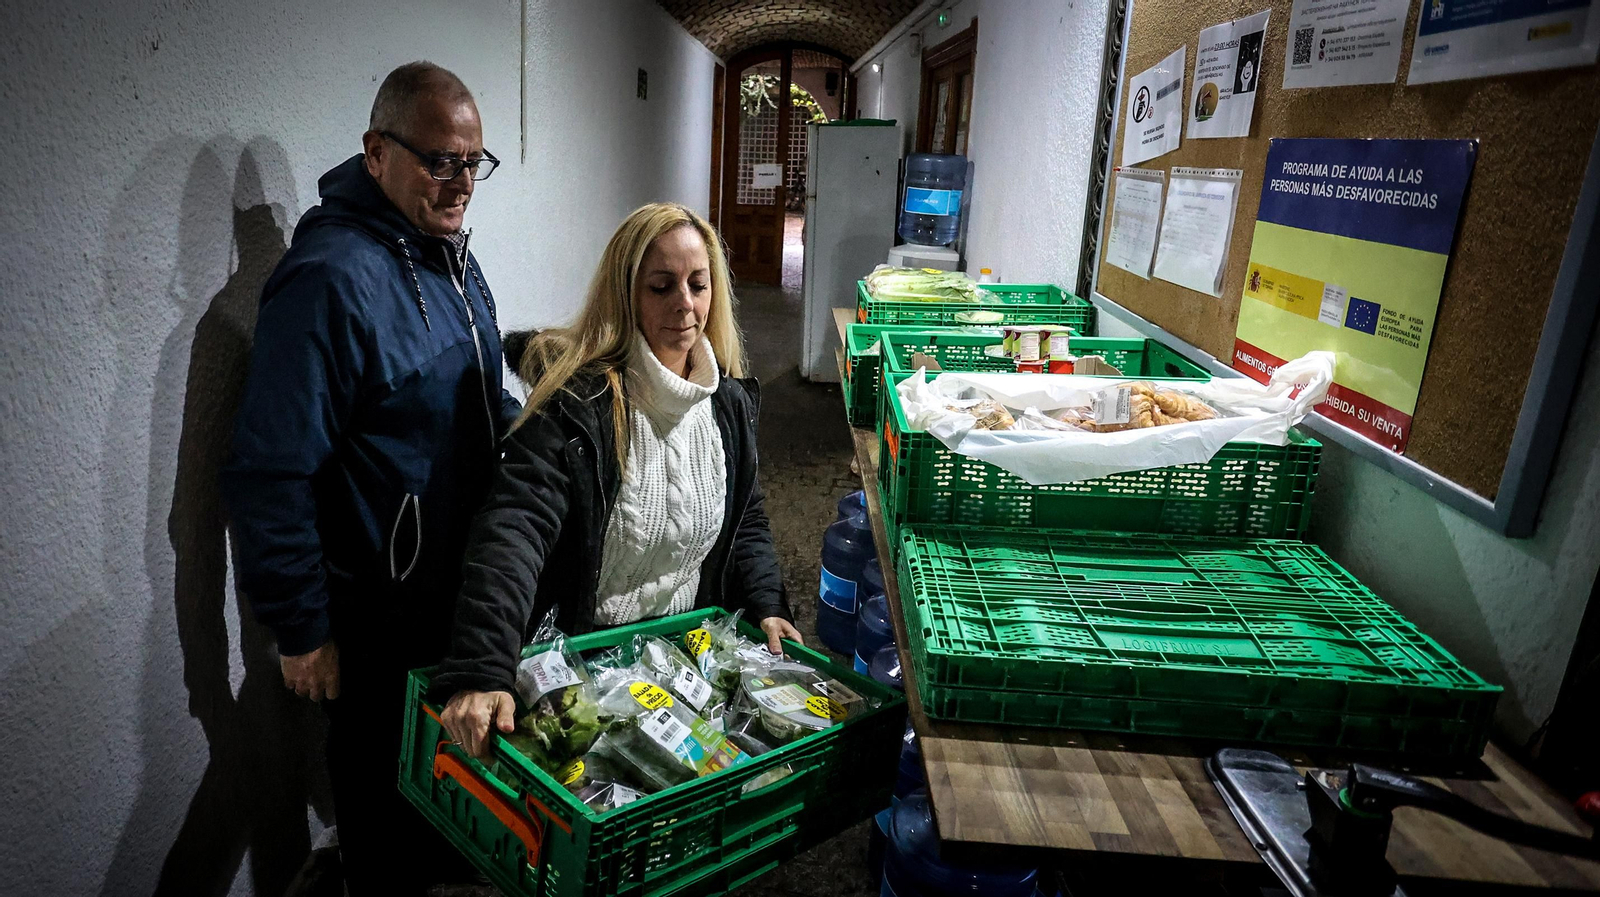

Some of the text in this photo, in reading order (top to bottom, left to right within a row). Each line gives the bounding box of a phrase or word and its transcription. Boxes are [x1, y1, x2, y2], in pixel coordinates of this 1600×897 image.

[1282, 161, 1423, 184] PROGRAMA DE AYUDA A LAS
[1270, 180, 1438, 210] PERSONAS MÁS DESFAVORECIDAS
[1380, 316, 1422, 333] EUROPEA PARA
[1382, 308, 1397, 317] FONDO
[1408, 316, 1424, 325] AYUDA
[1378, 330, 1420, 349] DESFAVORECIDAS
[1388, 326, 1410, 338] PERSONAS
[1411, 332, 1421, 342] MÁS
[1236, 350, 1266, 373] ALIMENTOS
[1325, 395, 1403, 440] HIBIDA SU VENTA
[1212, 644, 1238, 655] S.L.
[530, 661, 551, 687] TIERNA
[633, 684, 653, 699] BAJADA
[646, 692, 664, 705] PRECIO
